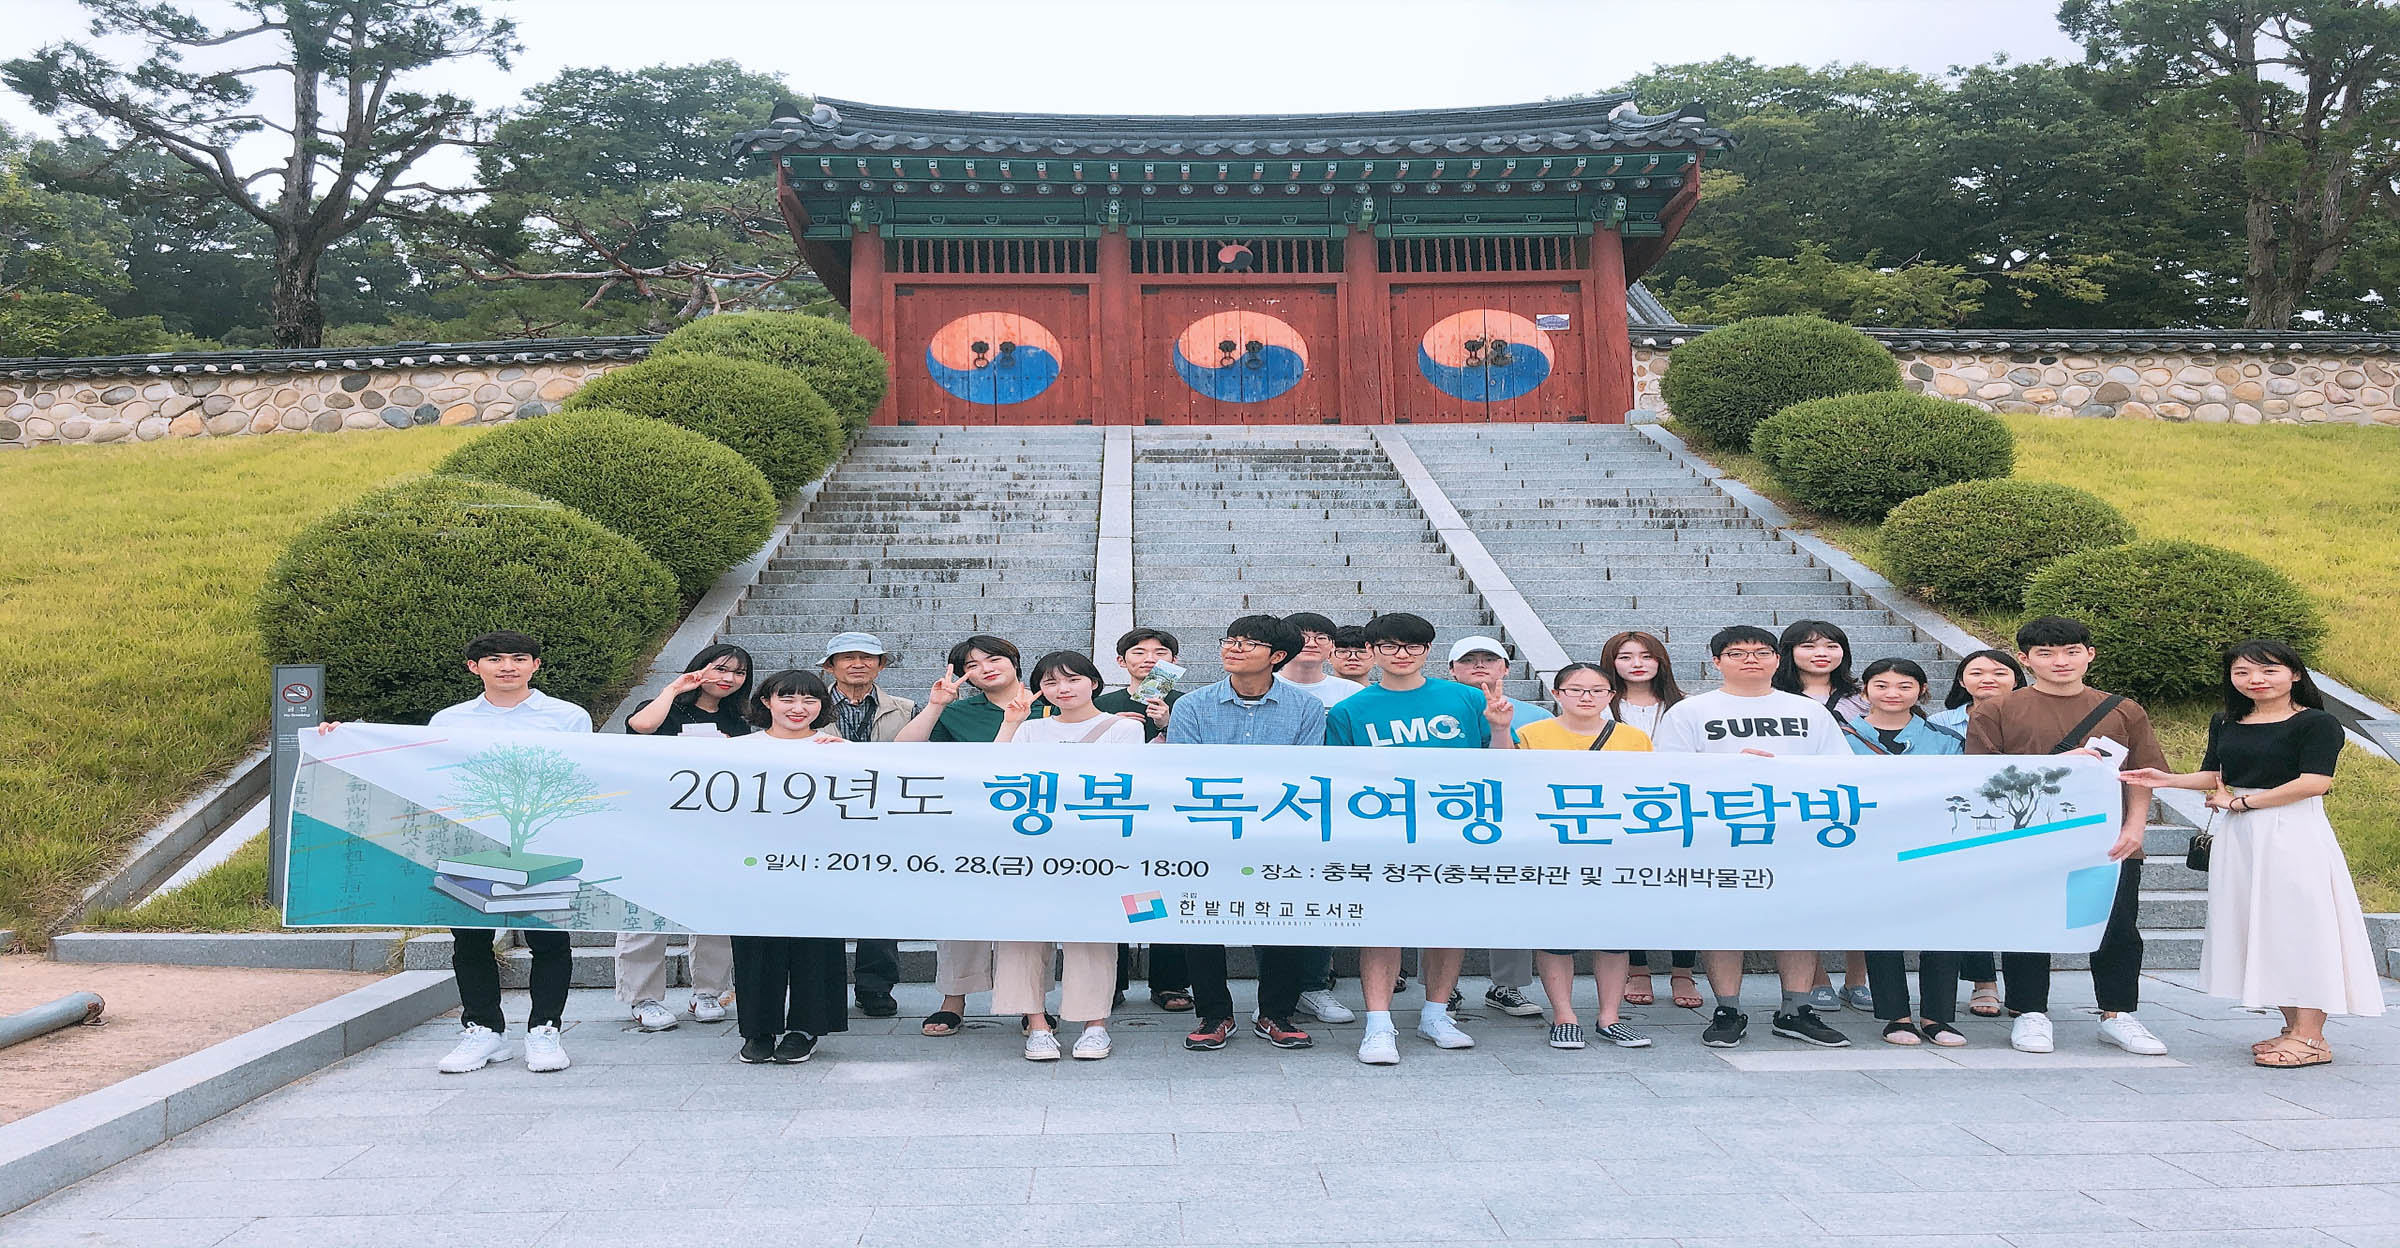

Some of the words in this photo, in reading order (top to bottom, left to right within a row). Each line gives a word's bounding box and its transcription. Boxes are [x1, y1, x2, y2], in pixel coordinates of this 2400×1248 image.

[1705, 717, 1808, 741] SURE!
[669, 768, 952, 821] 2019년도
[983, 771, 1149, 838] 행복
[1173, 776, 1503, 845] 독서여행
[1536, 781, 1878, 849] 문화탐방
[765, 854, 807, 872] 일시
[827, 853, 898, 873] 2019.
[906, 854, 945, 874] 06.
[955, 855, 1034, 877] 28.(금)
[1042, 857, 1130, 877] 09:00~
[1140, 859, 1210, 878] 18:00
[1261, 863, 1303, 881] 장소
[1322, 862, 1374, 883] 충북
[1382, 862, 1571, 886] 청주(충북문화관
[1581, 866, 1603, 887] 및
[1611, 866, 1775, 890] 고인쇄박물관)
[1180, 900, 1294, 919] 한밭대학교
[1304, 902, 1364, 919] 도서관
